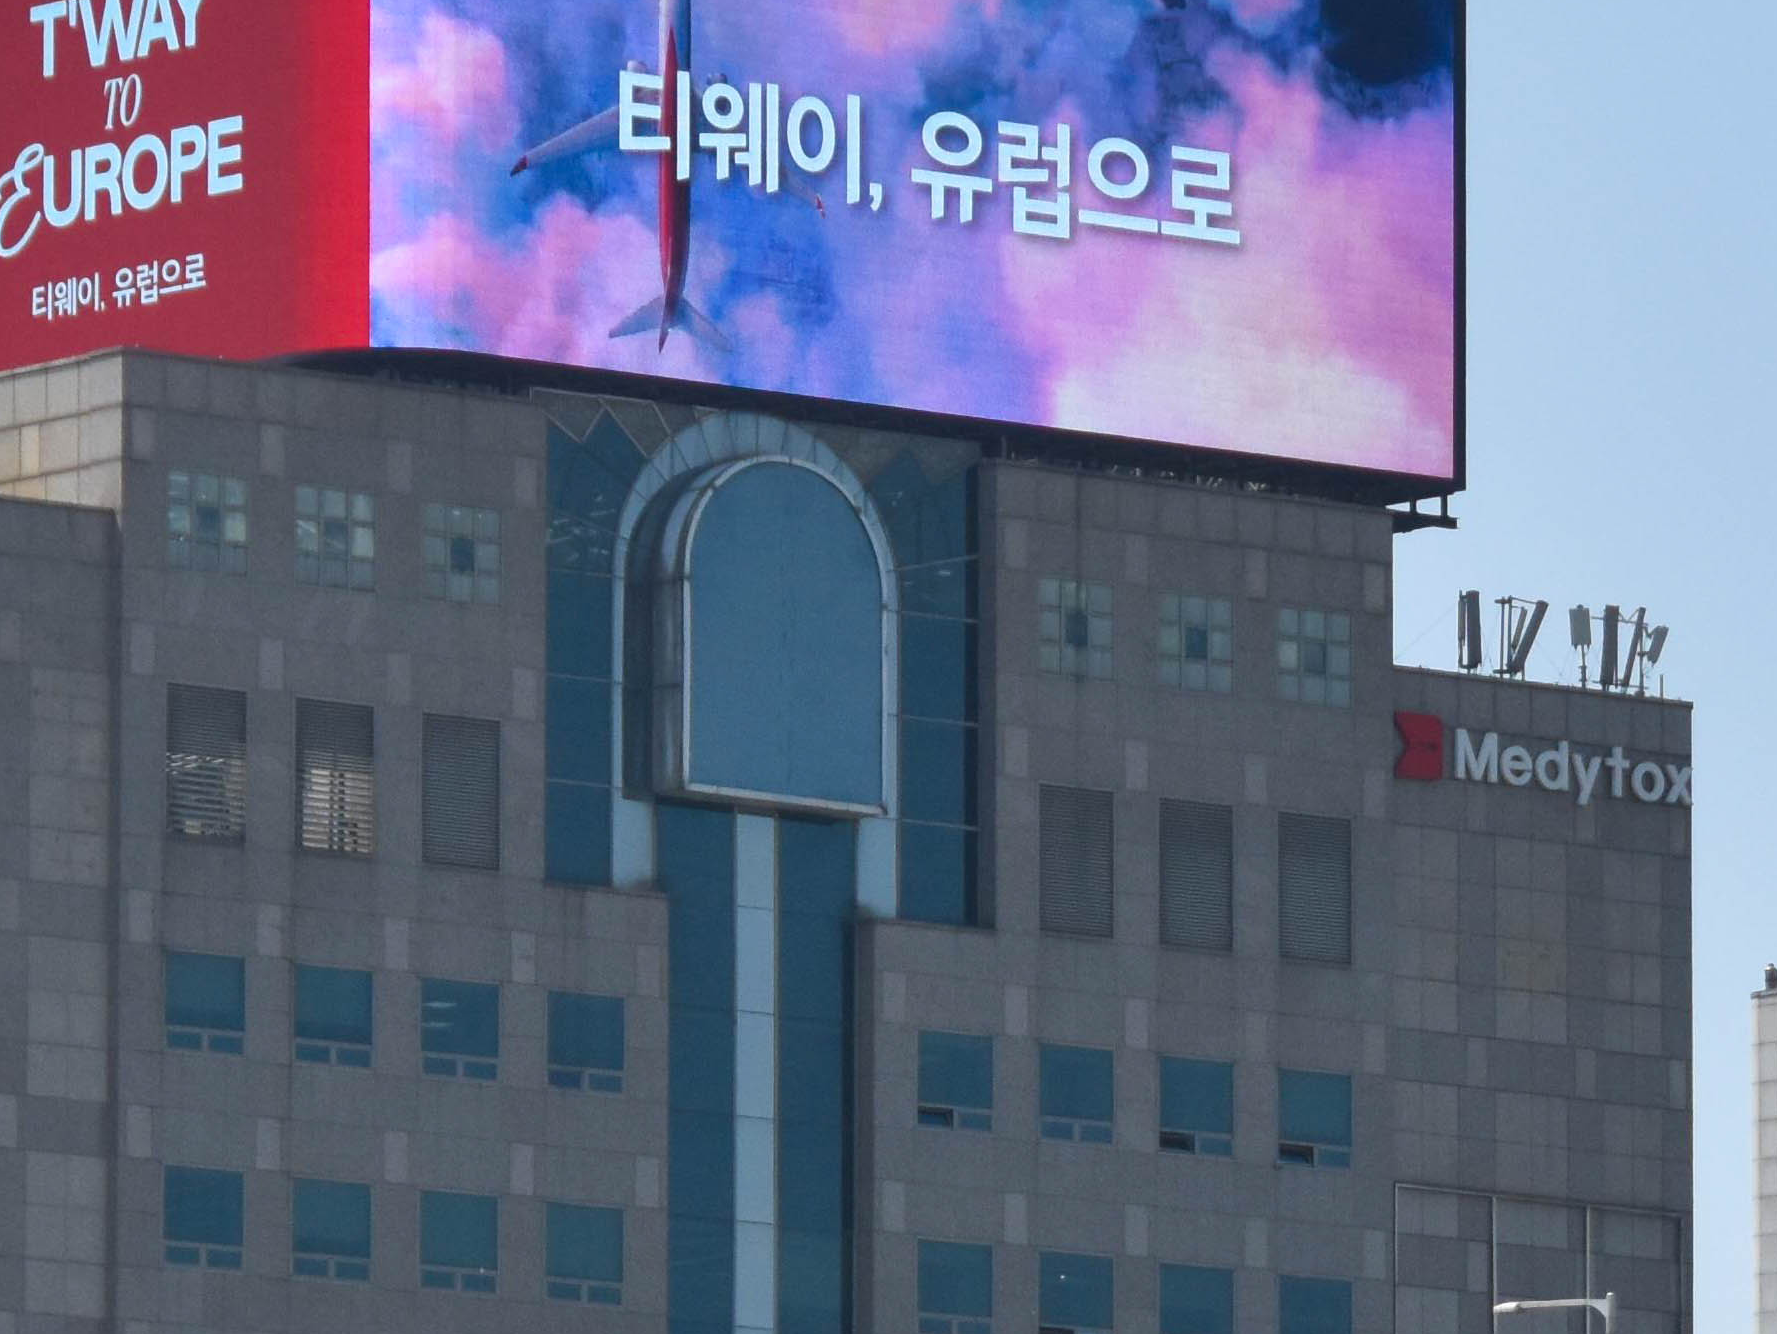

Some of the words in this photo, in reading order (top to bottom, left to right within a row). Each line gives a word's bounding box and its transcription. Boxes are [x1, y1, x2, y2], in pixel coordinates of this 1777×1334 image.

[103, 73, 142, 130] TO
[619, 69, 884, 212] 티웨이,
[911, 110, 1241, 245] 유럽으로
[31, 271, 105, 322] 티웨이,
[112, 253, 207, 309] 유럽으로
[1454, 728, 1693, 806] Medytox
